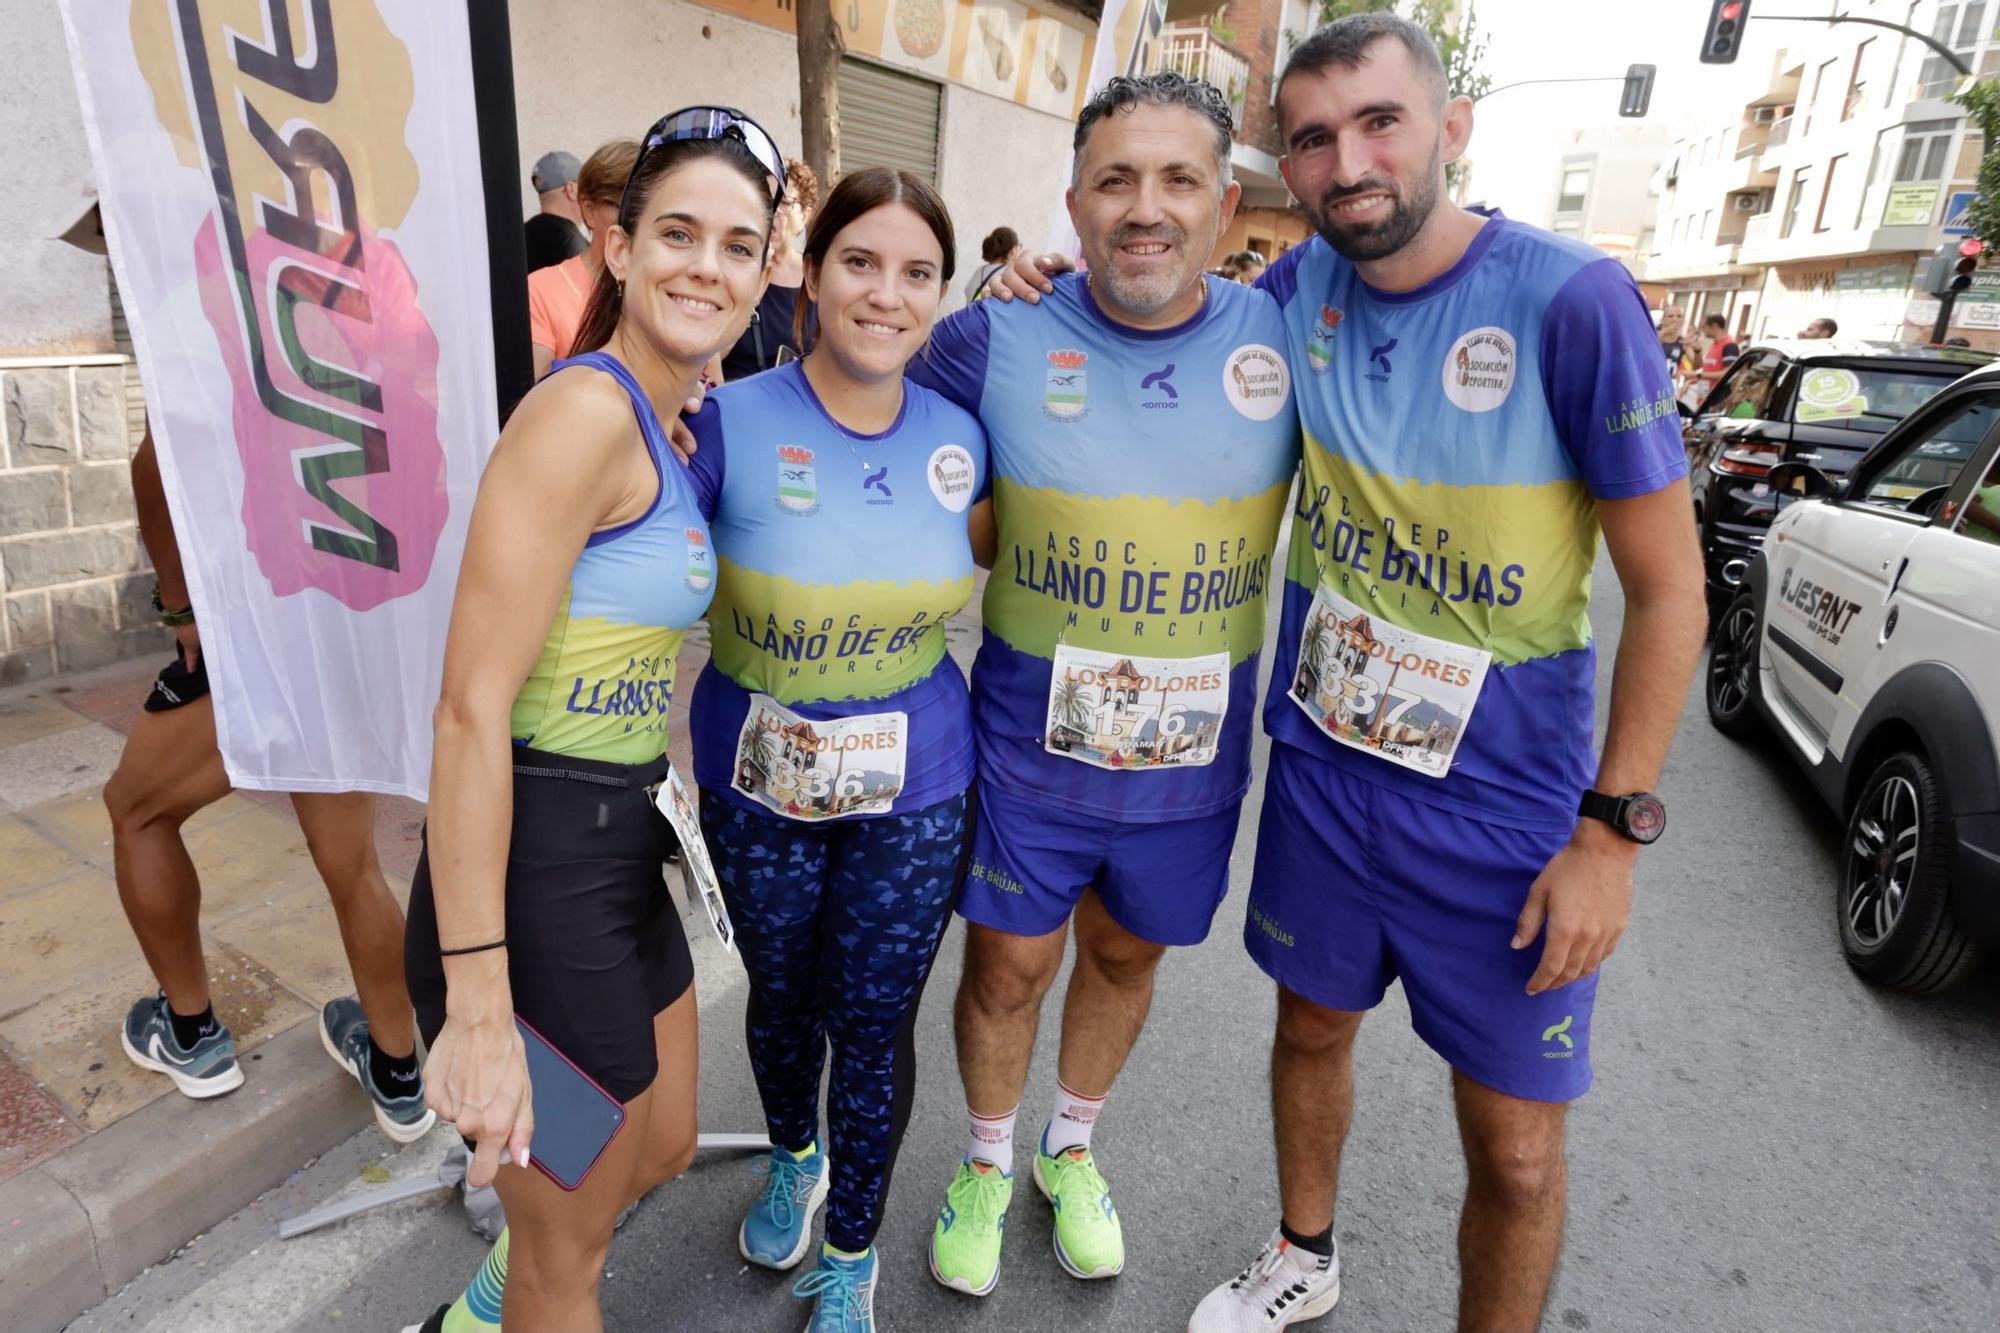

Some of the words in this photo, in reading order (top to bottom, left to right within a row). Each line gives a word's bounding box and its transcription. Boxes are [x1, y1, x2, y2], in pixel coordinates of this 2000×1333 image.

[1047, 531, 1157, 566] ASOC.
[1195, 537, 1251, 566] DEP.
[1332, 519, 1375, 574] DE
[1381, 535, 1525, 608] BRUJAS
[1014, 544, 1106, 609] LLANO
[1119, 569, 1170, 615] DE
[1179, 554, 1267, 615] BRUJAS
[1067, 611, 1227, 637] MURCIA
[1786, 577, 1863, 634] JESANT
[733, 607, 828, 662] LLANO
[836, 627, 886, 658] DE
[1314, 604, 1345, 636] LOS
[1351, 632, 1472, 687] DOLORES
[1064, 666, 1106, 687] LOS
[1117, 673, 1222, 693] DOLORES
[1320, 656, 1423, 727] 337
[758, 707, 790, 741] LOS
[1093, 702, 1188, 738] 176
[770, 755, 867, 798] 336
[972, 864, 986, 878] DE
